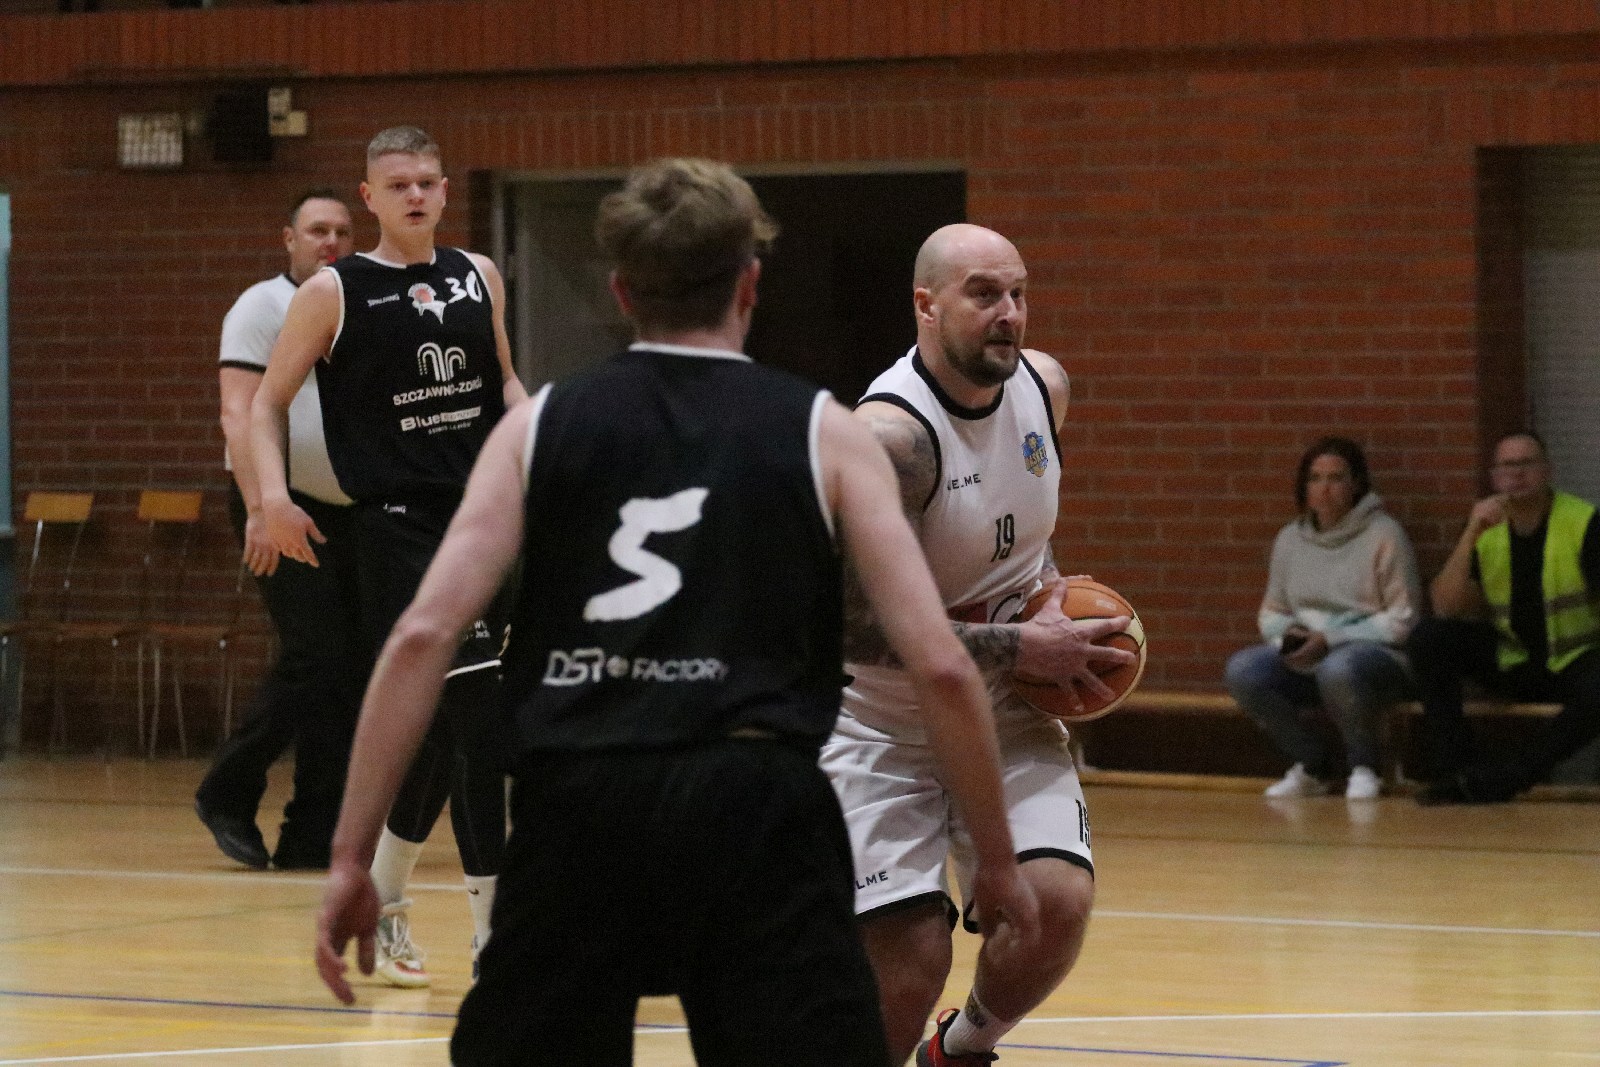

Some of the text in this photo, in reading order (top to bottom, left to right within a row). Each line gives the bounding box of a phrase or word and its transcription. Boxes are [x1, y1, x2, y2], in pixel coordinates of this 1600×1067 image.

[445, 270, 482, 304] 30
[582, 486, 710, 622] 5
[990, 513, 1015, 563] 19
[855, 870, 889, 890] LME
